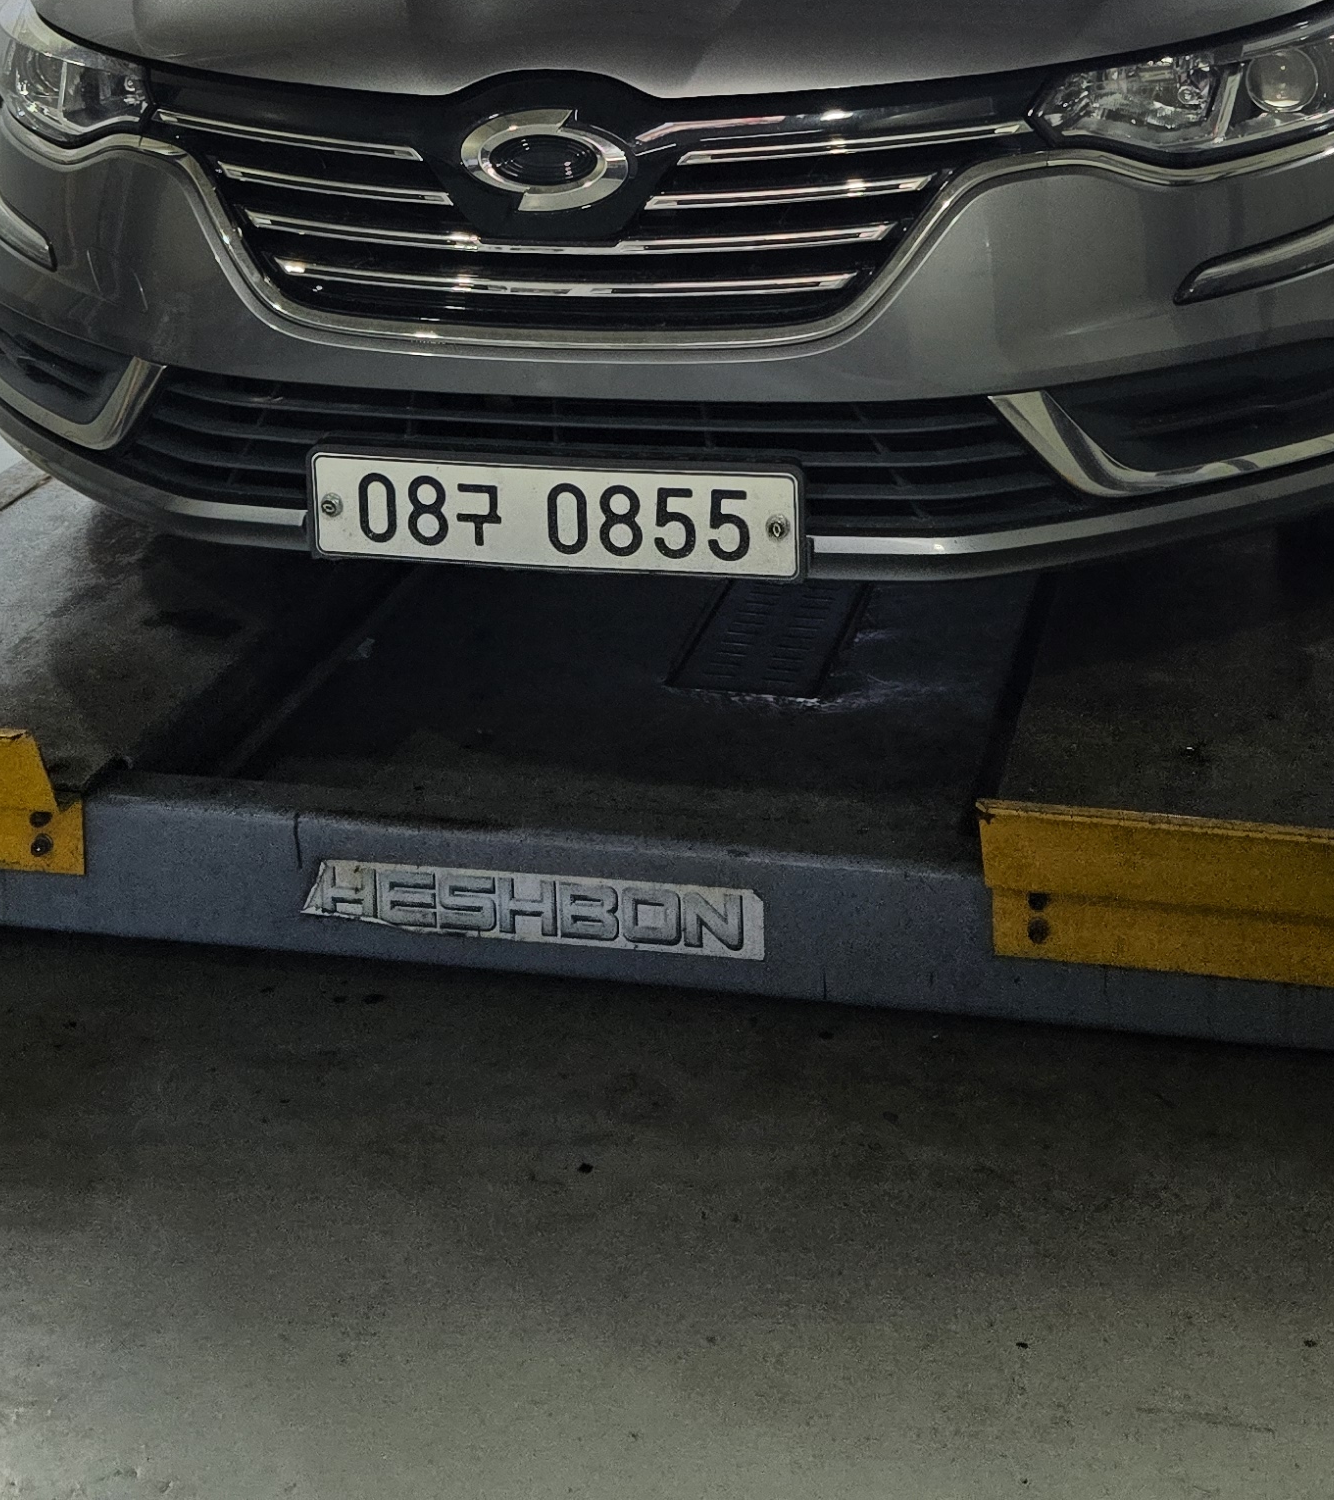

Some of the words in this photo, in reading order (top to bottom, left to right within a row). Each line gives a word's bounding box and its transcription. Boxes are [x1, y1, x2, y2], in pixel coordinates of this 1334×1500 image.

[357, 472, 503, 547] 08구
[547, 482, 751, 562] 0855
[321, 866, 745, 952] HESHBON
